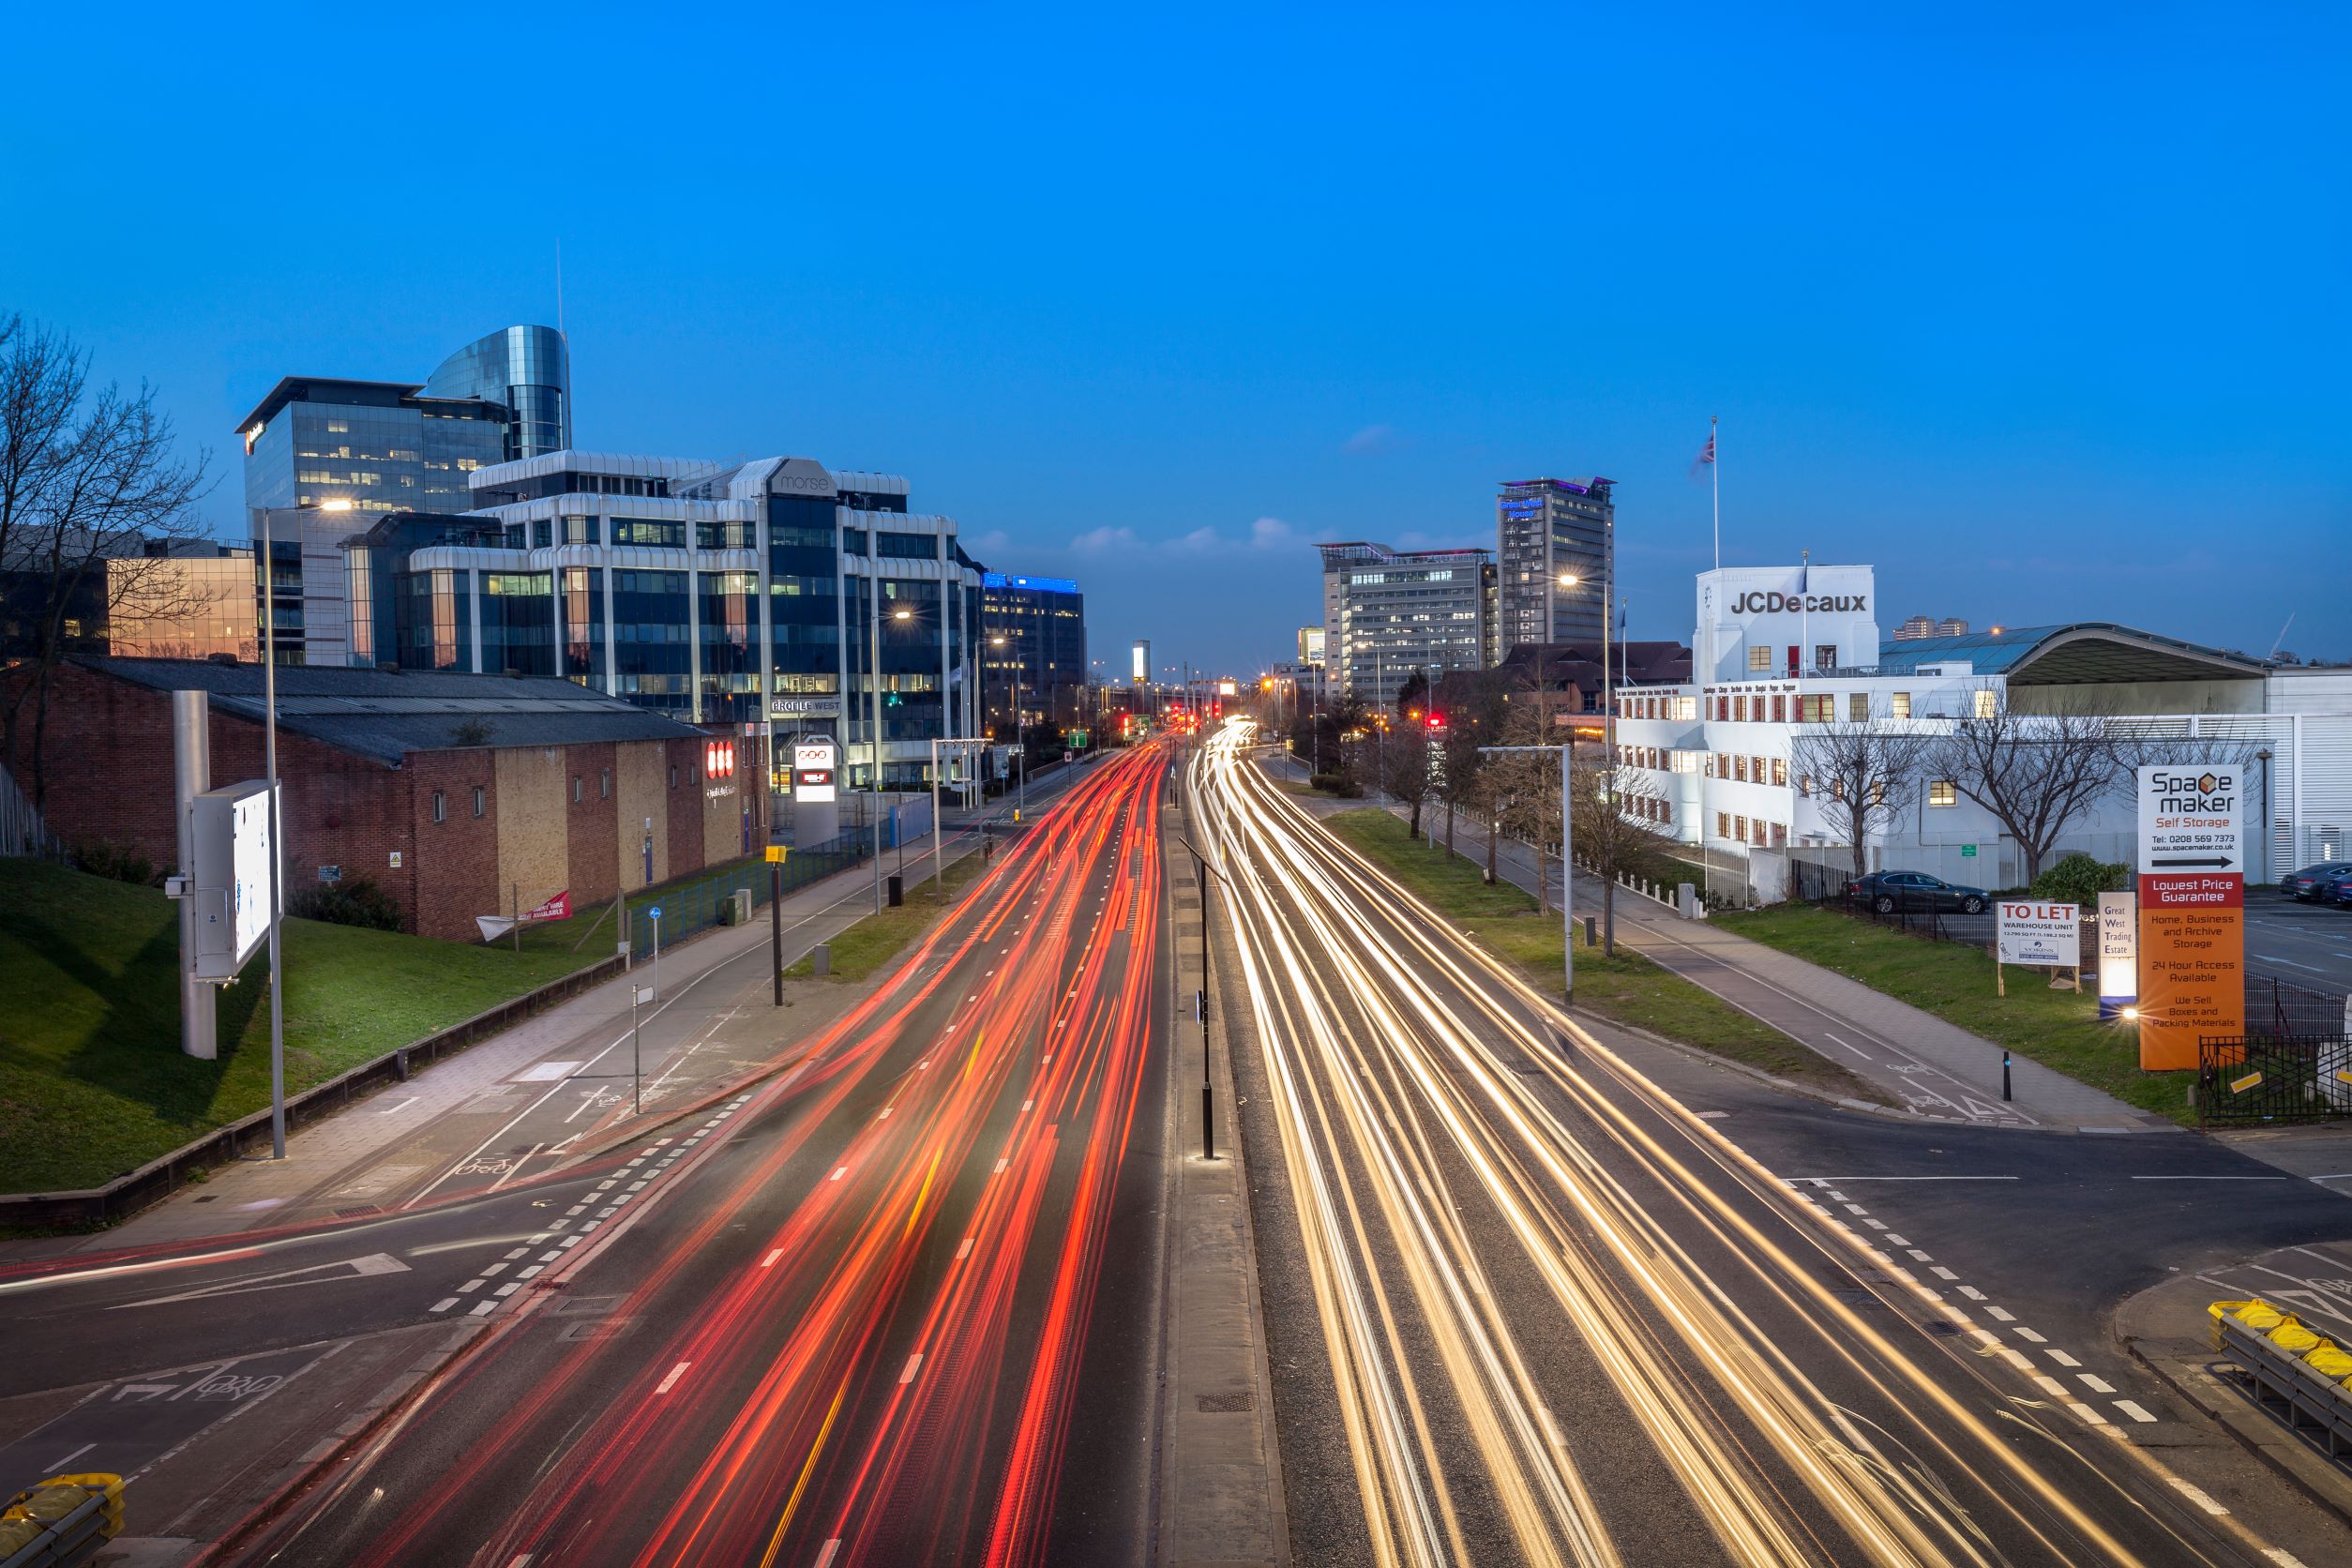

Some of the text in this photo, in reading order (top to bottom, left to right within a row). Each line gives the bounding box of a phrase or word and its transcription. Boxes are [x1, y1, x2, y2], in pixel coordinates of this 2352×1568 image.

[781, 476, 828, 490] morse
[1731, 592, 1866, 613] JCDecaux
[772, 701, 840, 711] PROFILE WEST
[2151, 772, 2232, 795] Space
[2160, 793, 2235, 813] maker
[2156, 817, 2230, 829] Self Storage
[2152, 836, 2166, 844] Tel:
[2194, 835, 2212, 843] 569
[2214, 834, 2235, 842] 7373
[2153, 879, 2234, 891] Lowest Price
[2161, 891, 2225, 902] Guarantee
[2002, 905, 2074, 920] TO LET
[2104, 906, 2125, 915] Great
[2104, 918, 2125, 928] West
[2151, 914, 2235, 925] Home, Business
[2003, 922, 2053, 930] WAREHOUSE
[2104, 931, 2132, 943] Trading
[2163, 927, 2223, 937] and Archive
[2104, 944, 2128, 954] Estate
[2173, 939, 2212, 949] Storage
[2152, 960, 2235, 971] 24 Hour Access
[2169, 972, 2217, 983] Available
[2175, 995, 2212, 1004] We Sell
[2169, 1006, 2218, 1017] Boxes and
[2152, 1018, 2236, 1029] Packing Materials
